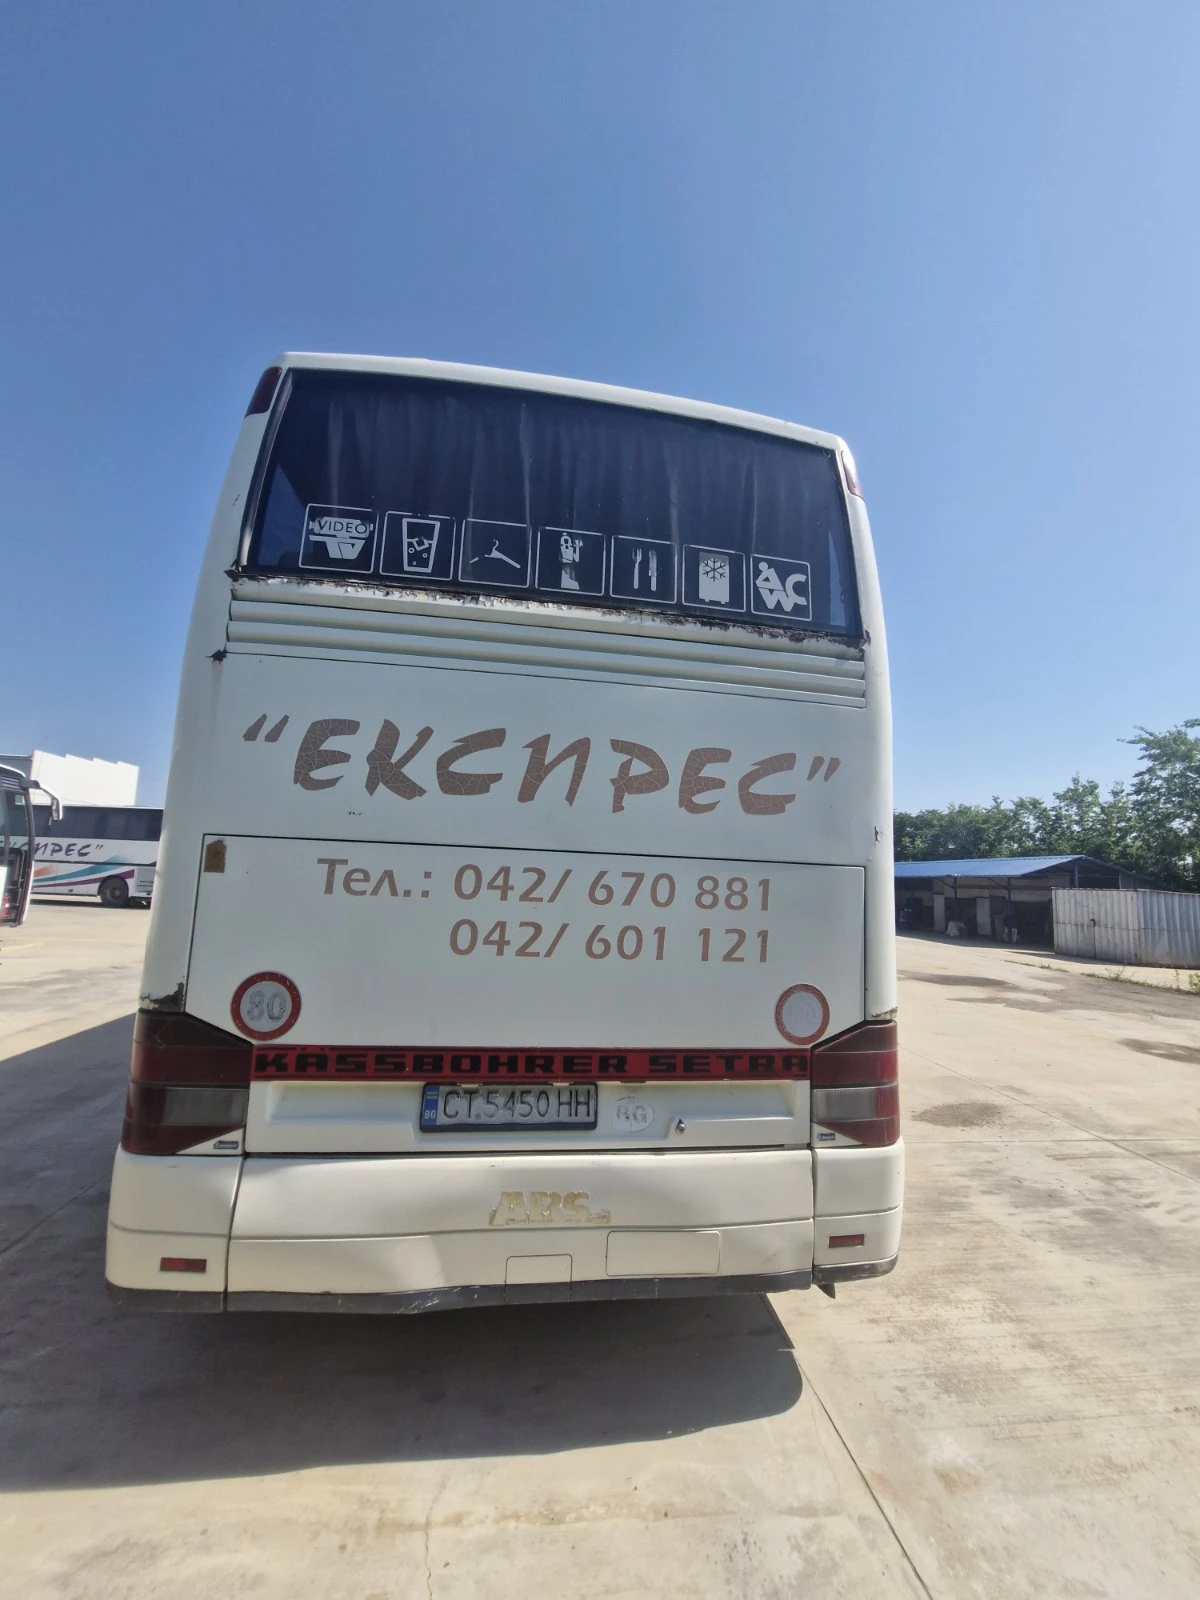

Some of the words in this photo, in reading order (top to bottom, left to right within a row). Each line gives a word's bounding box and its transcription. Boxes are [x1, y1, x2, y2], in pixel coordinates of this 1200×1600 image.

[317, 519, 368, 535] VIDEO
[316, 858, 433, 899] Тел.:
[453, 863, 573, 904] 042/
[587, 870, 677, 909] 670
[694, 875, 772, 912] 881
[449, 918, 570, 959] 042/
[584, 924, 667, 961] 601
[698, 928, 770, 964] 121
[648, 1054, 809, 1075] SETRA
[424, 1109, 436, 1119] BG
